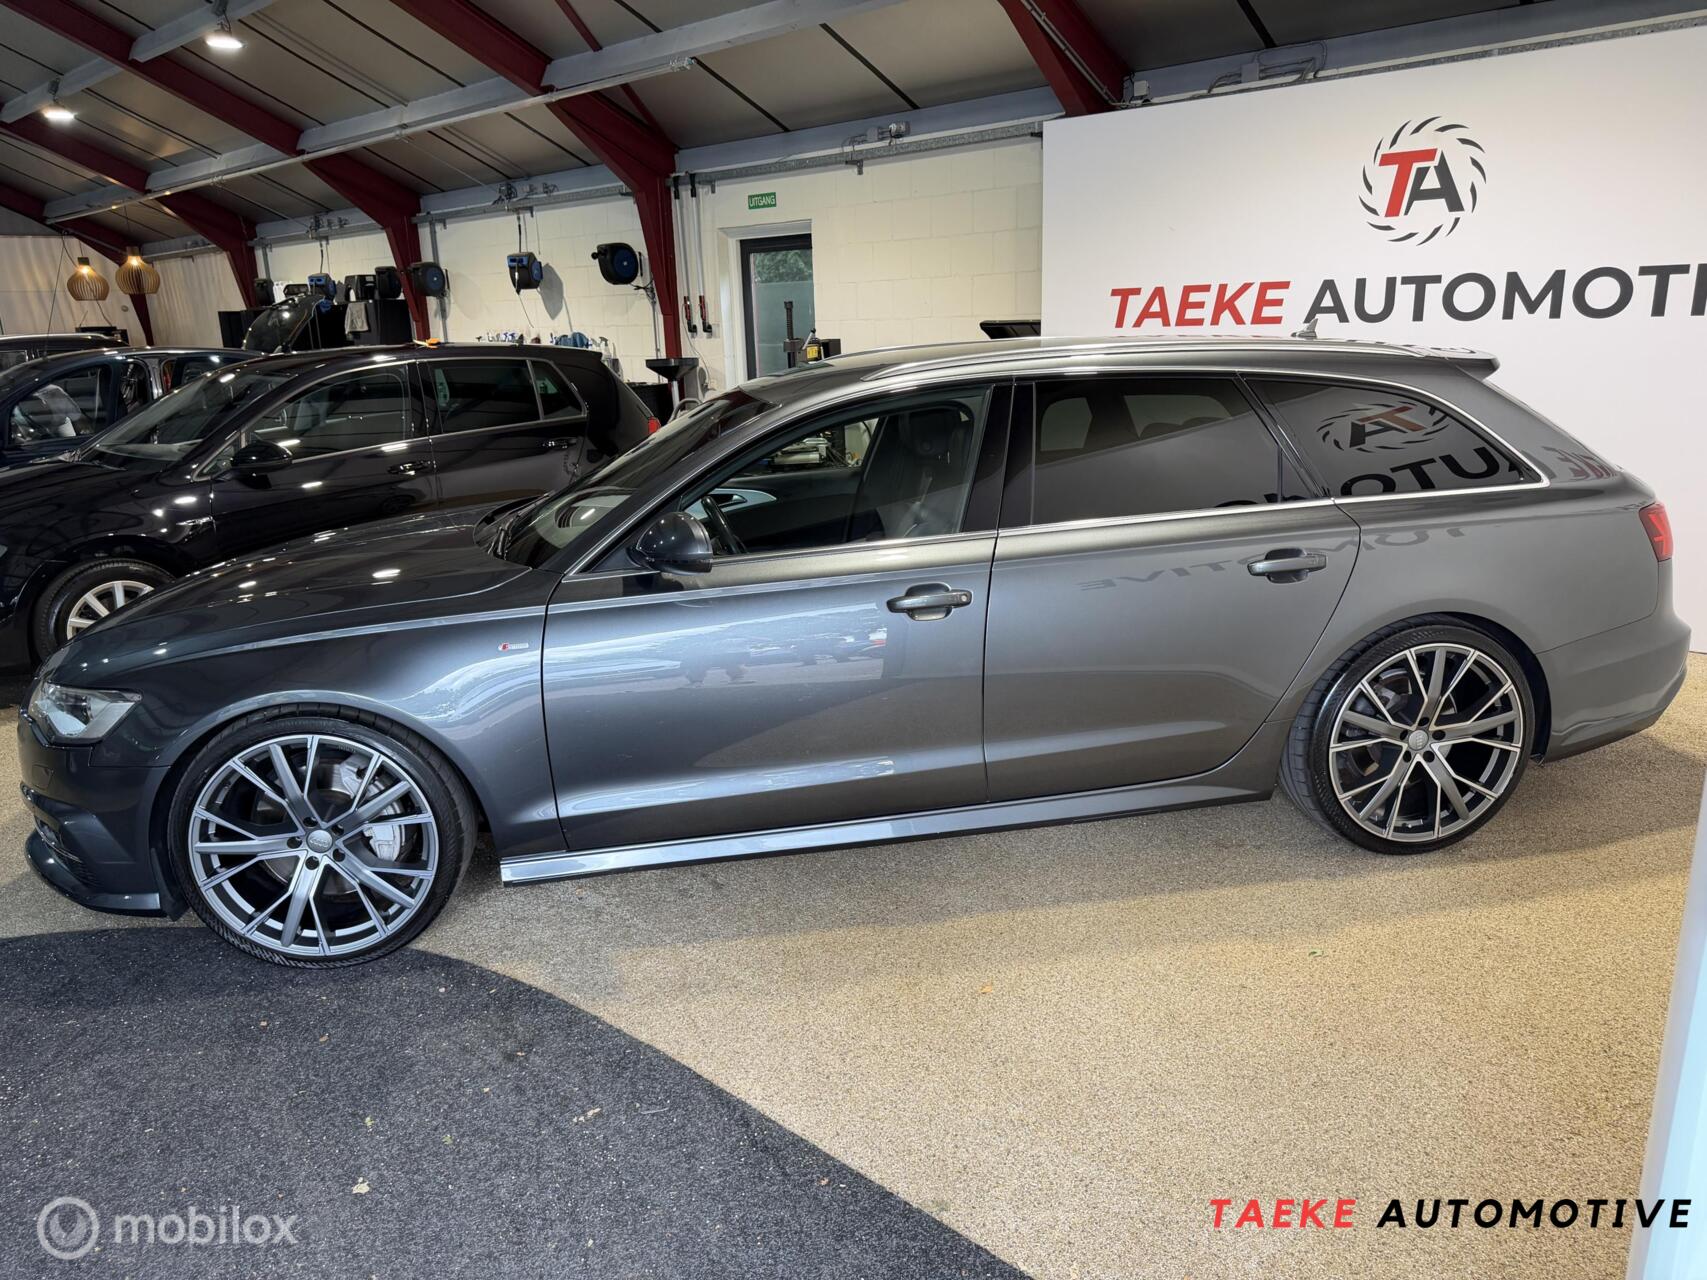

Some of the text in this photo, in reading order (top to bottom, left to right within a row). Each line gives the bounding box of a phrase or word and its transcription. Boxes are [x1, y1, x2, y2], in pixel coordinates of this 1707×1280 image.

[750, 195, 775, 207] UITGANG
[1379, 148, 1465, 218] TA
[1110, 281, 1291, 329] TAEKE
